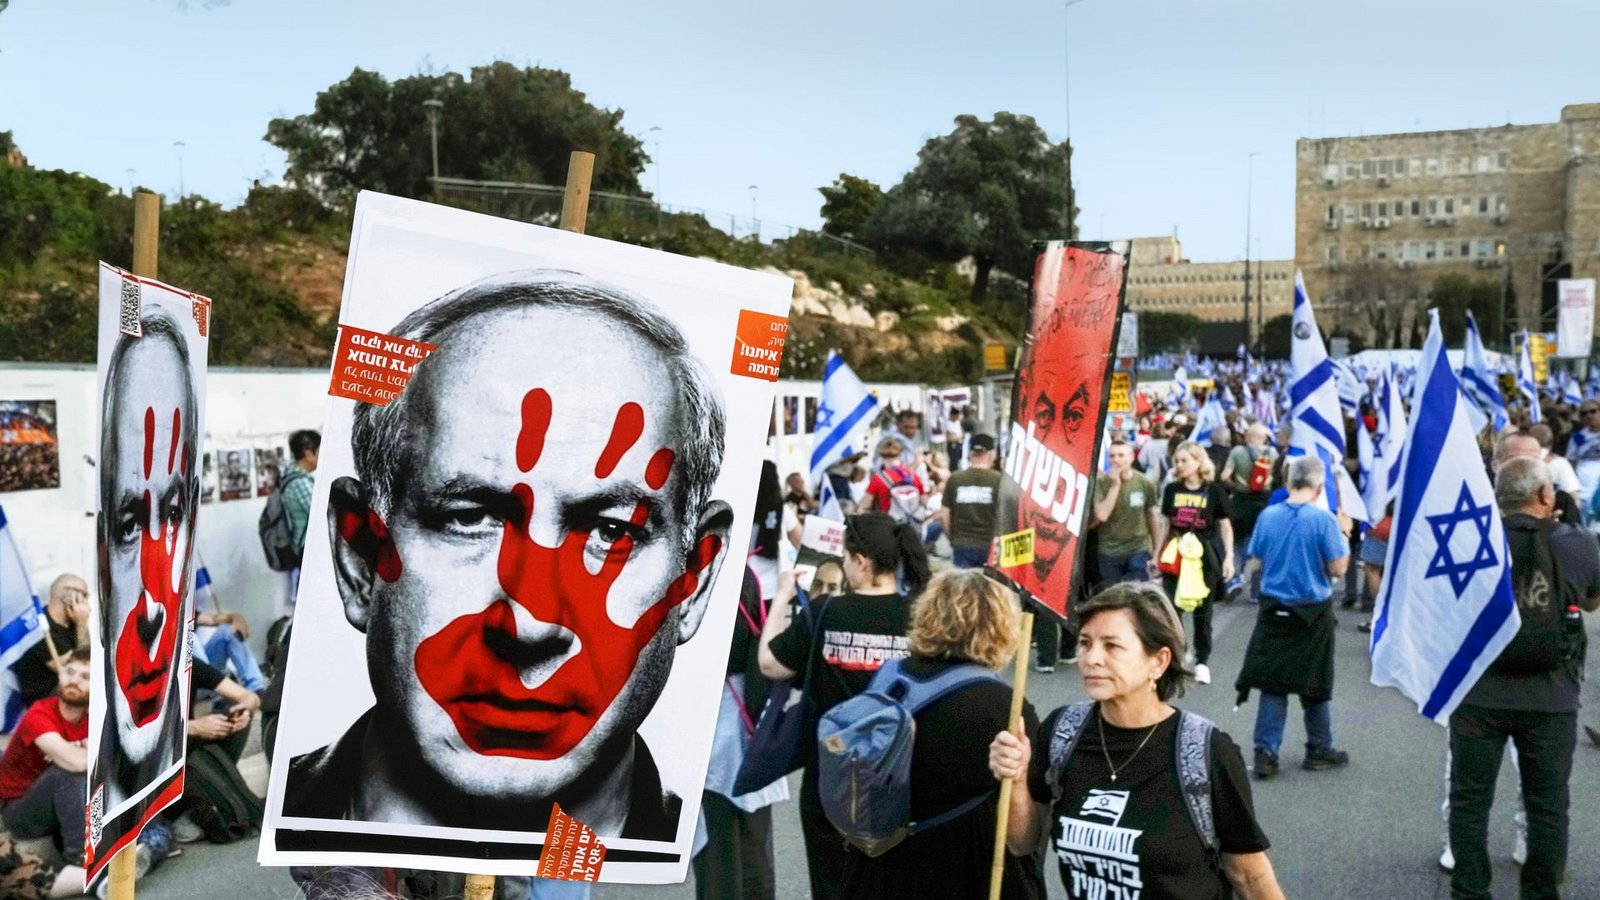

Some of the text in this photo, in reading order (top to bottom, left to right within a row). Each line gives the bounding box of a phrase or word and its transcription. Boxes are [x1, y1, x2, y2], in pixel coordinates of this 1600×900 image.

[351, 334, 381, 349] סרקו
[383, 341, 403, 354] את
[740, 343, 778, 361] איתנו!
[347, 349, 386, 368] אנחנו
[344, 366, 357, 379] על
[360, 370, 384, 383] עתיד
[748, 362, 780, 376] תרומה
[341, 380, 372, 398] בשביל
[1005, 420, 1089, 538] נכשלת
[548, 818, 565, 852] להמשיך
[568, 817, 578, 835] ינה
[570, 845, 588, 876] אותך
[1057, 849, 1143, 889] בחירות
